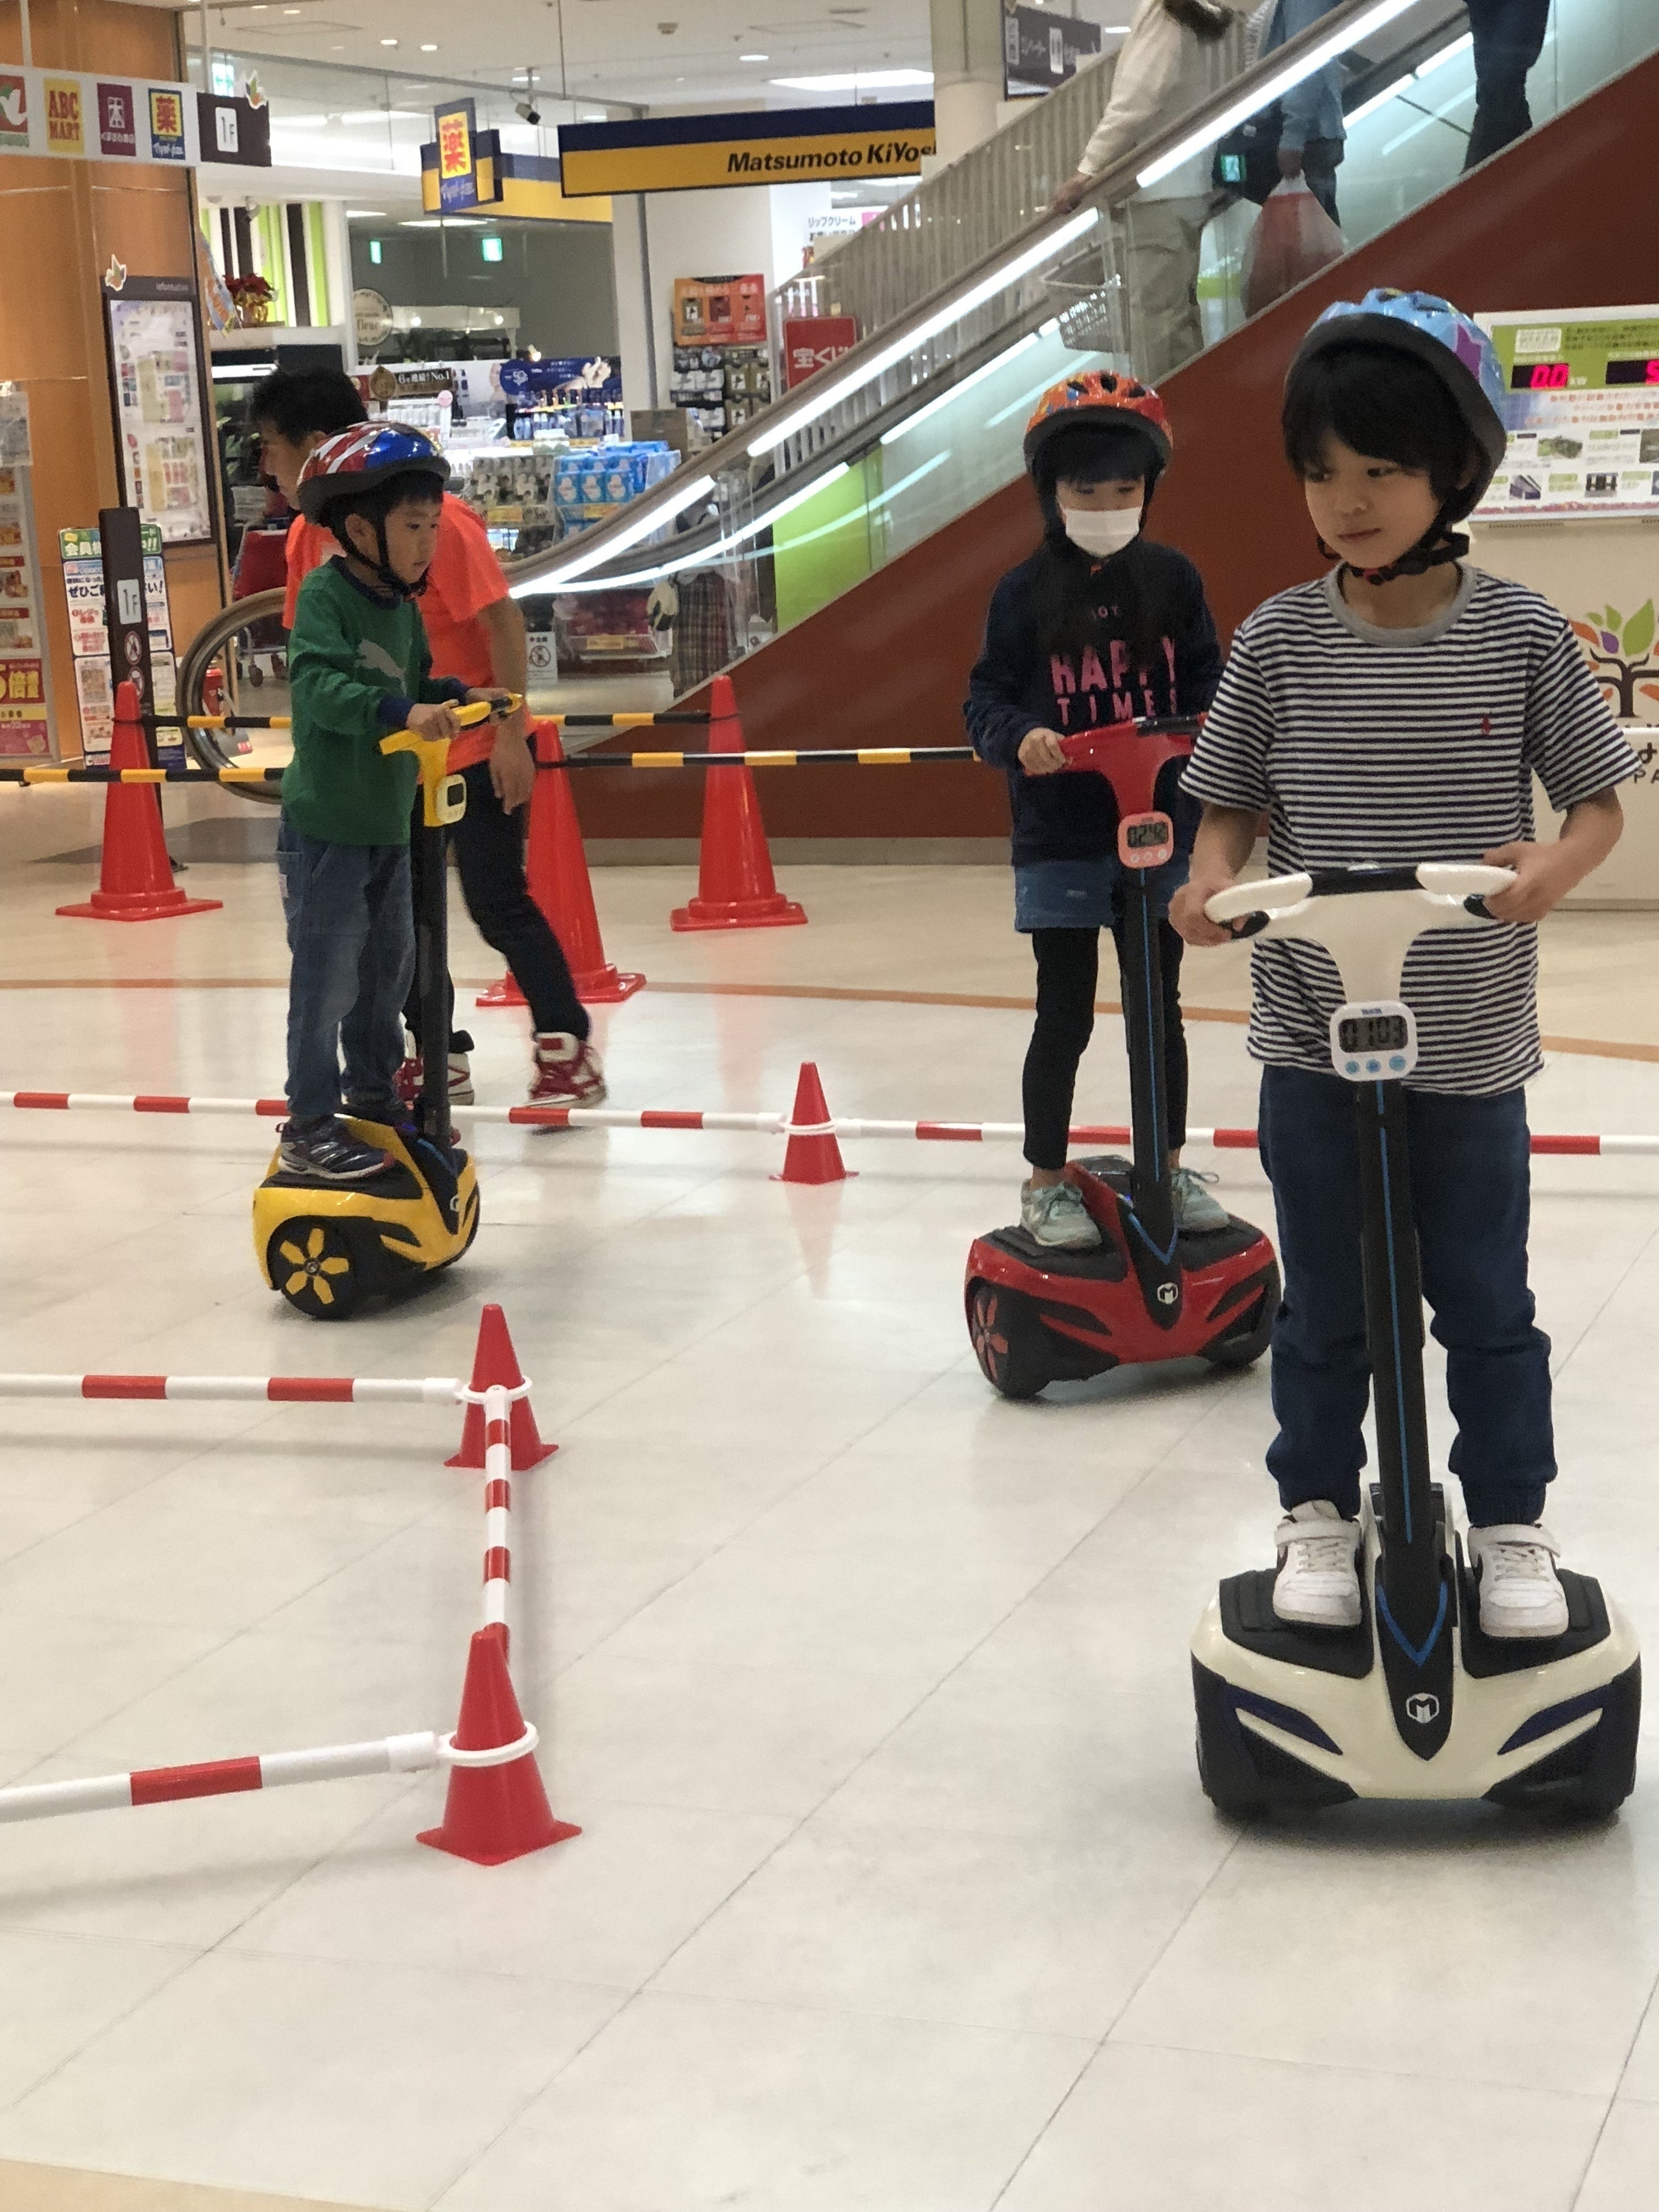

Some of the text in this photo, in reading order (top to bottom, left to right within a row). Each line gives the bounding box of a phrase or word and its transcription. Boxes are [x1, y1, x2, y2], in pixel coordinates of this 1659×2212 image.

[48, 89, 79, 120] ABC
[155, 95, 178, 133] 薬
[49, 121, 80, 141] MART
[441, 119, 467, 172] 薬
[727, 140, 936, 173] Matsumoto KiYos
[808, 216, 856, 228] リップクリーム
[792, 347, 850, 369] 宝くじ
[123, 589, 138, 615] 1F
